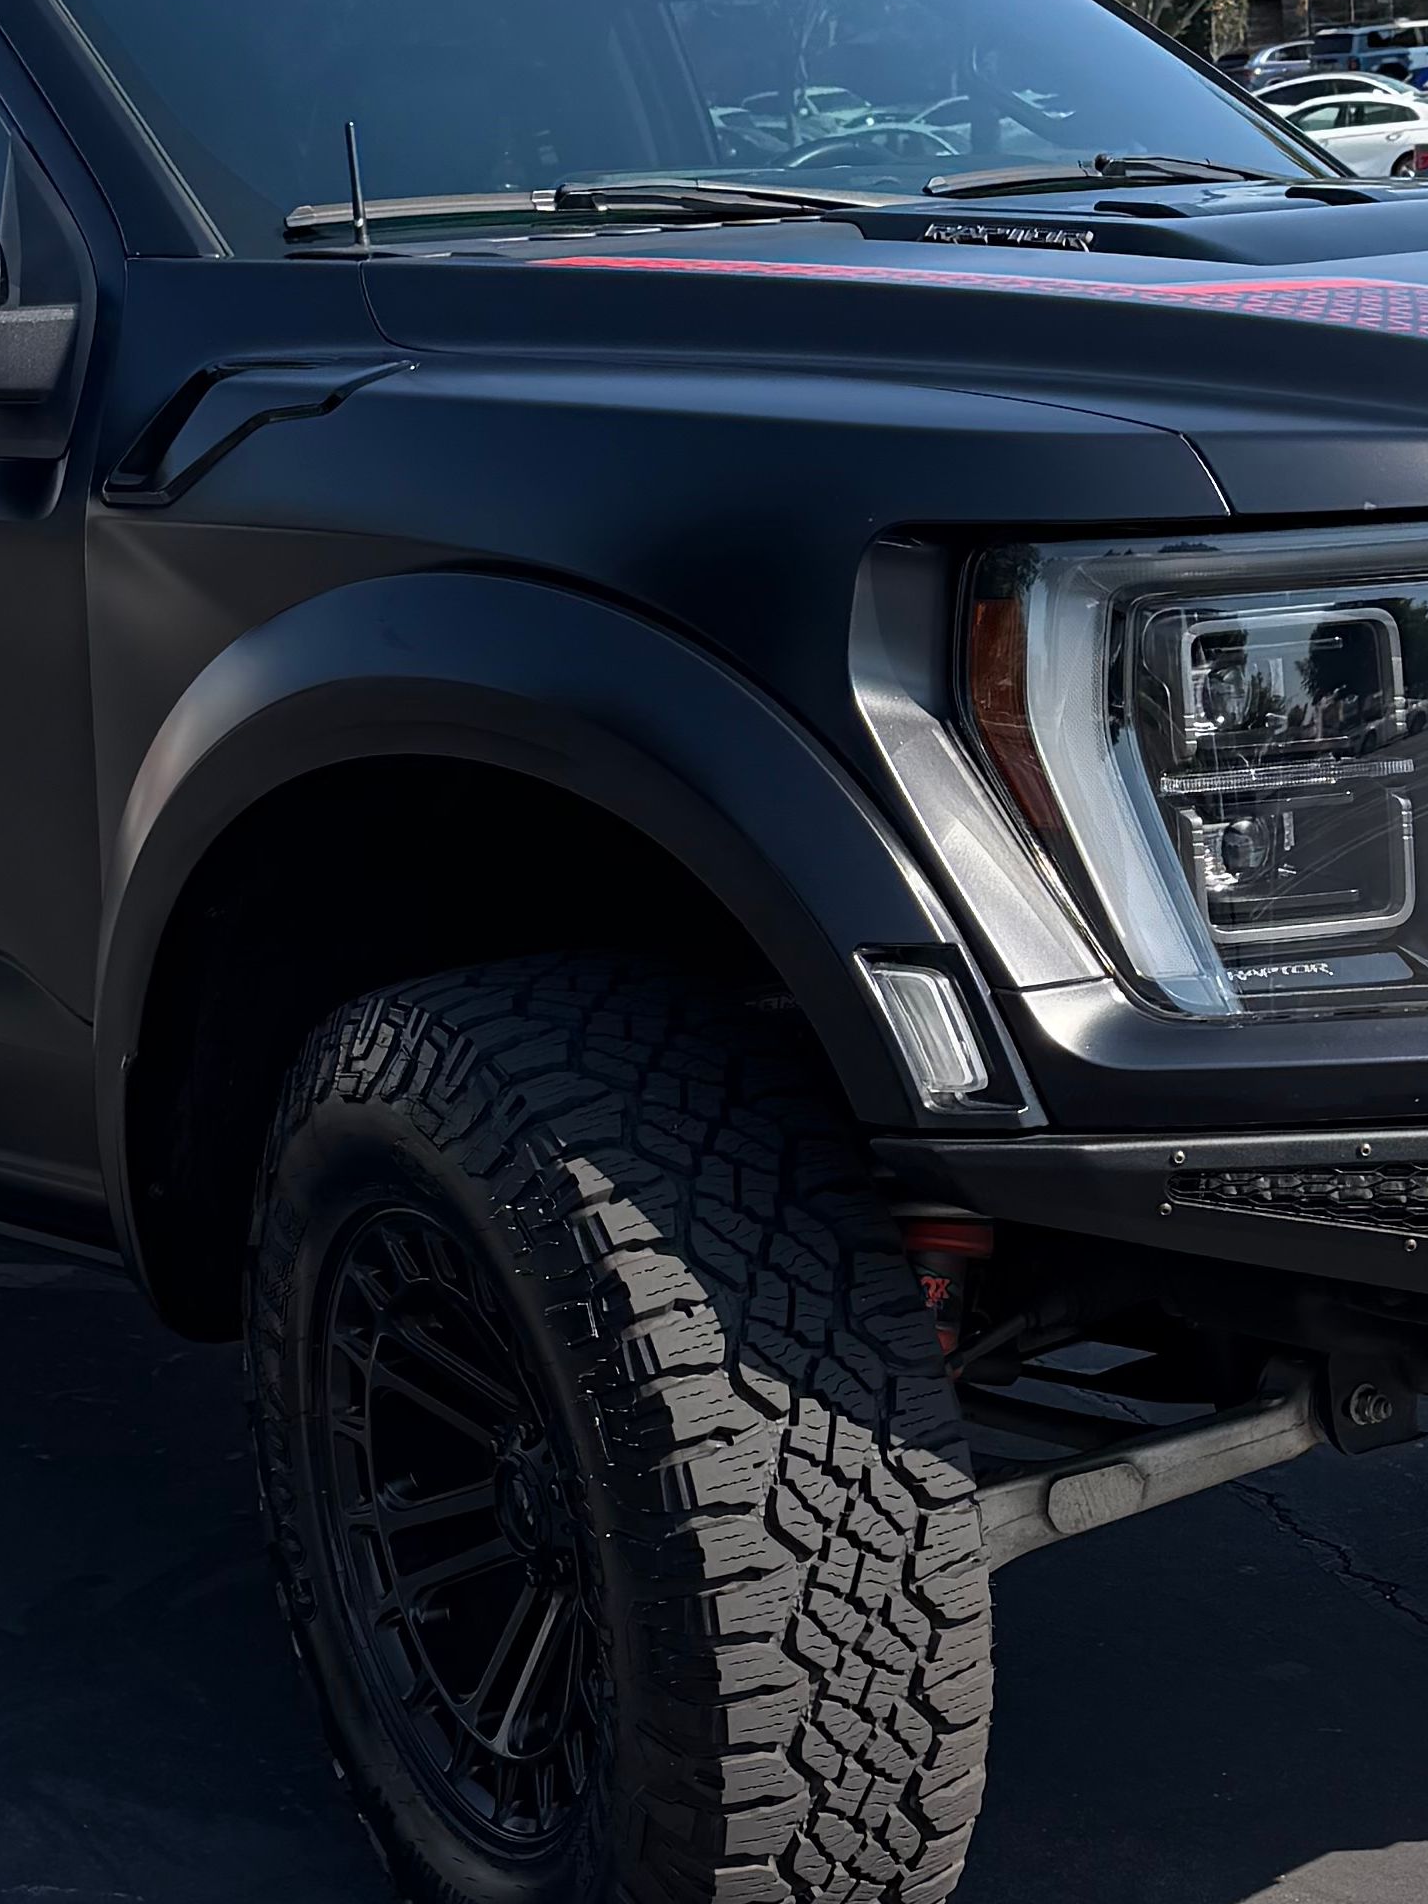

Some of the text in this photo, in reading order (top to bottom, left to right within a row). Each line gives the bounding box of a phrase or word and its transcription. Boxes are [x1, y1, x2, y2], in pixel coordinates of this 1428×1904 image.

[924, 223, 1094, 253] RAPTOR
[1227, 962, 1334, 982] RAPTOR
[920, 1275, 952, 1299] OX
